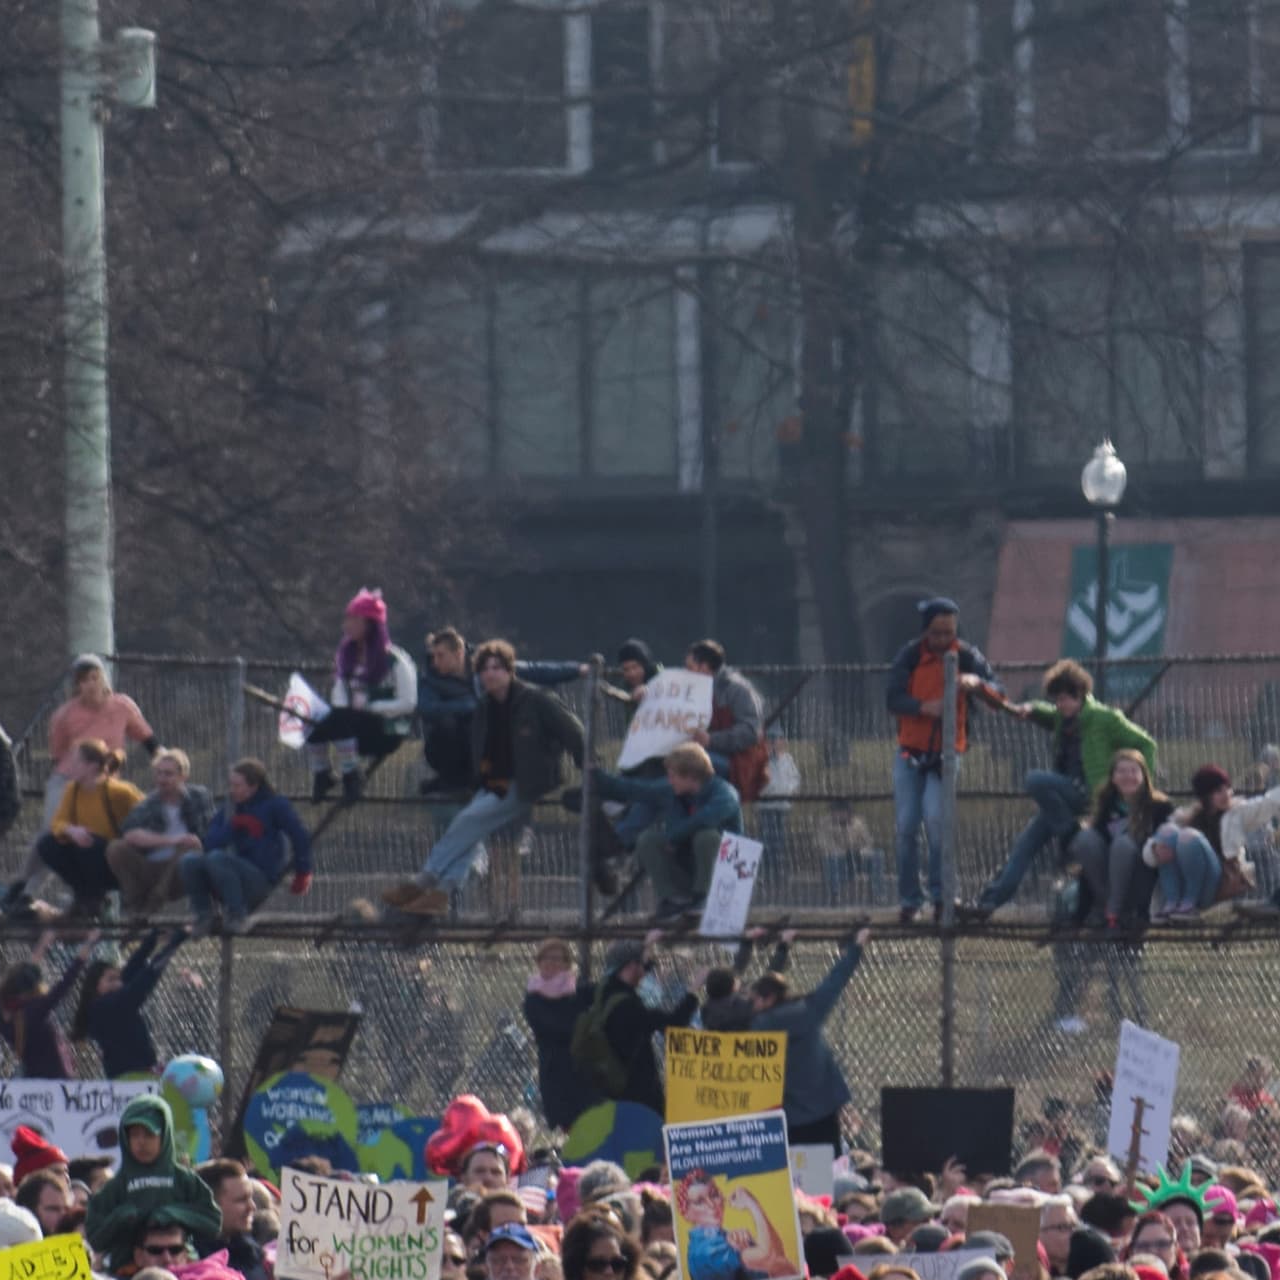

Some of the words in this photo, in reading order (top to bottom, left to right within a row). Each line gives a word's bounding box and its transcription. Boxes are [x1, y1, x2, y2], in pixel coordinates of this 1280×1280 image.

[669, 1032, 721, 1056] NEVER
[733, 1038, 778, 1057] MIND
[701, 1060, 782, 1083] BOLLOCKS
[266, 1087, 328, 1104] WOMEN
[261, 1102, 335, 1123] WORKING
[669, 1123, 723, 1141] Women's
[726, 1119, 766, 1136] Rights
[671, 1142, 693, 1156] Are
[695, 1136, 738, 1152] Human
[741, 1131, 785, 1150] Rights!
[290, 1175, 394, 1225] STAND
[286, 1220, 320, 1255] for
[350, 1252, 428, 1280] RIGHTS
